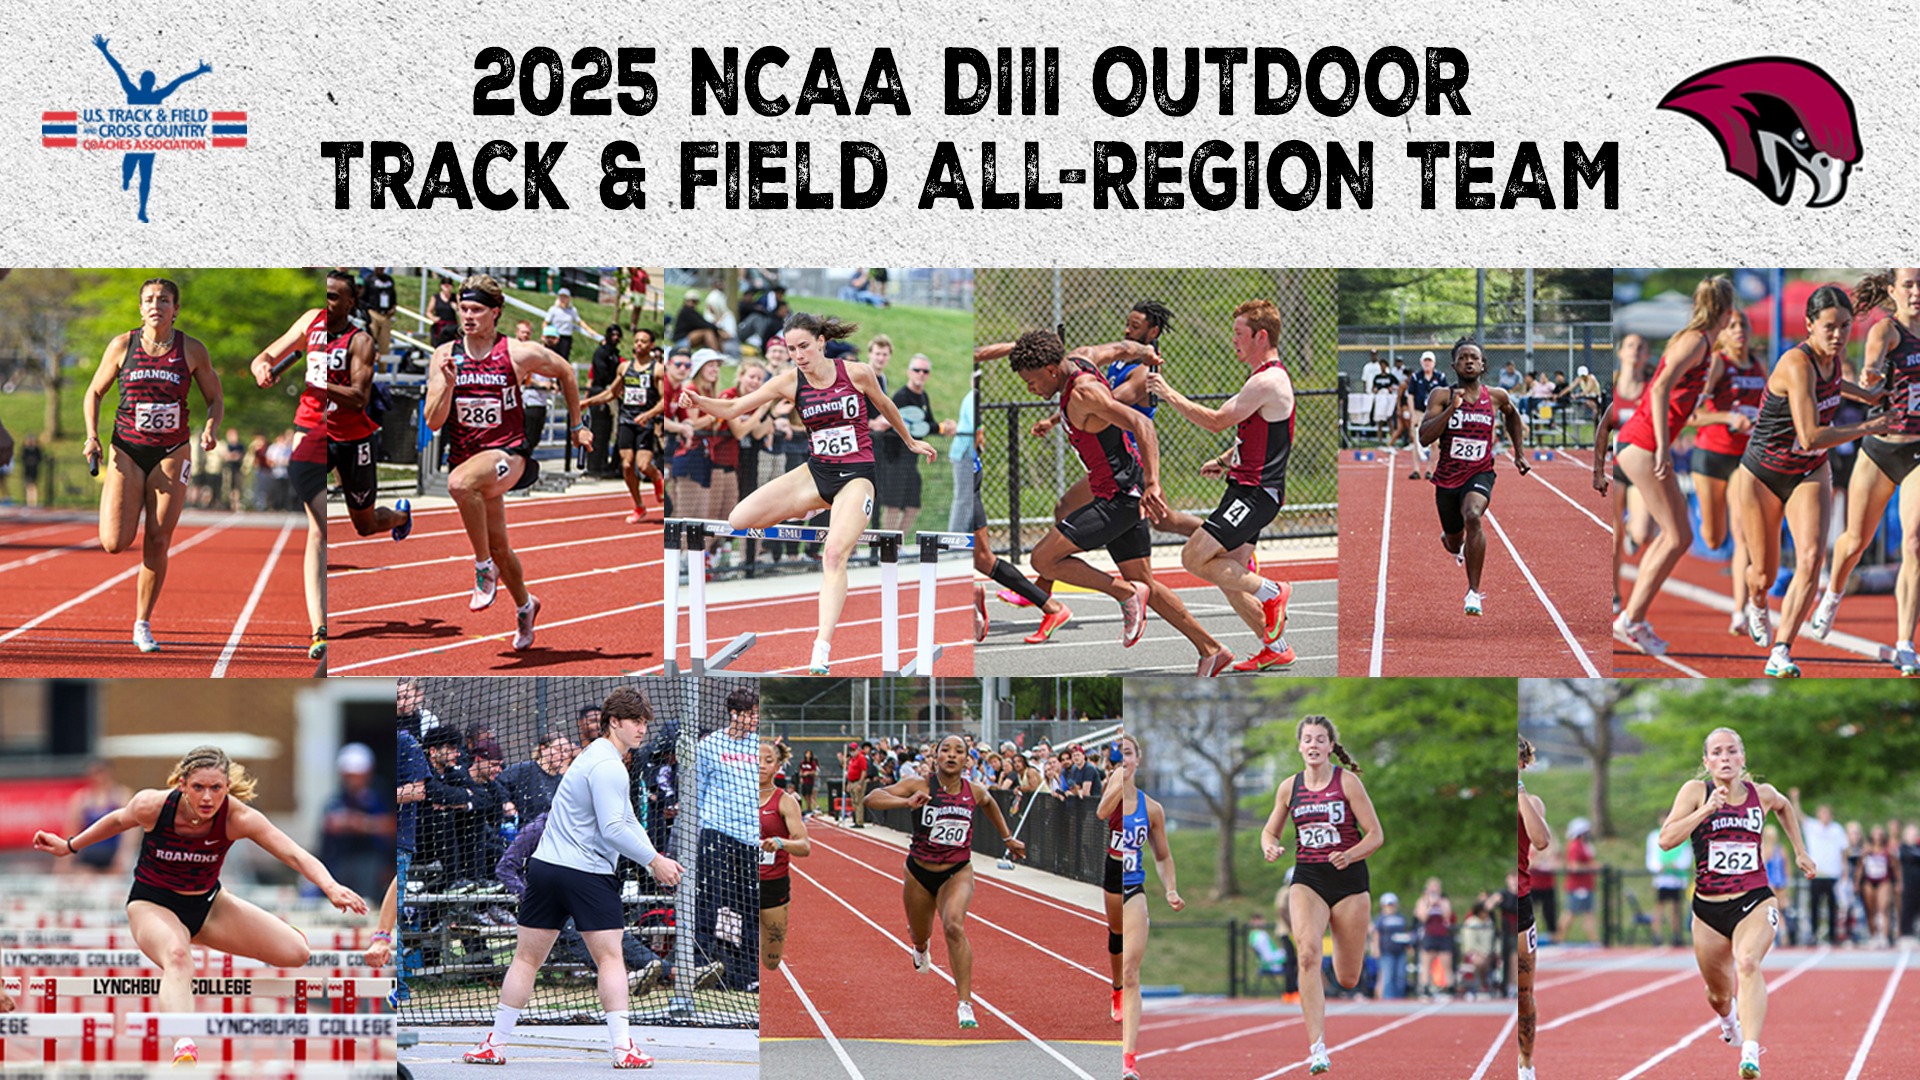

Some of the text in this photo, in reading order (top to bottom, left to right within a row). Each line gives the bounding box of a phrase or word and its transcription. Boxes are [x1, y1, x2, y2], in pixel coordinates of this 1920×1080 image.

[333, 350, 344, 369] 5
[129, 369, 181, 385] ROANOKE
[505, 388, 515, 407] 4
[461, 407, 498, 424] 286
[846, 397, 857, 418] 6
[140, 413, 176, 429] 263
[1450, 410, 1460, 428] 5
[818, 436, 853, 455] 265
[1455, 443, 1482, 458] 281
[865, 499, 873, 516] 6
[1229, 505, 1244, 522] 4
[706, 524, 726, 534] GILL
[778, 527, 802, 539] EMU
[941, 537, 961, 545] GILL
[924, 807, 934, 826] 6
[1332, 803, 1342, 822] 5
[1751, 808, 1760, 830] 5
[933, 825, 964, 842] 260
[1114, 832, 1123, 850] 7
[1136, 826, 1146, 846] 6
[1304, 829, 1335, 846] 261
[156, 849, 218, 863] ROANOKE
[1713, 851, 1753, 871] 262
[3, 953, 141, 967] LYNCHBURG COLLEGE
[93, 978, 161, 995] LYNCHBU
[206, 1018, 393, 1036] LYNCHBURG COLLEGE
